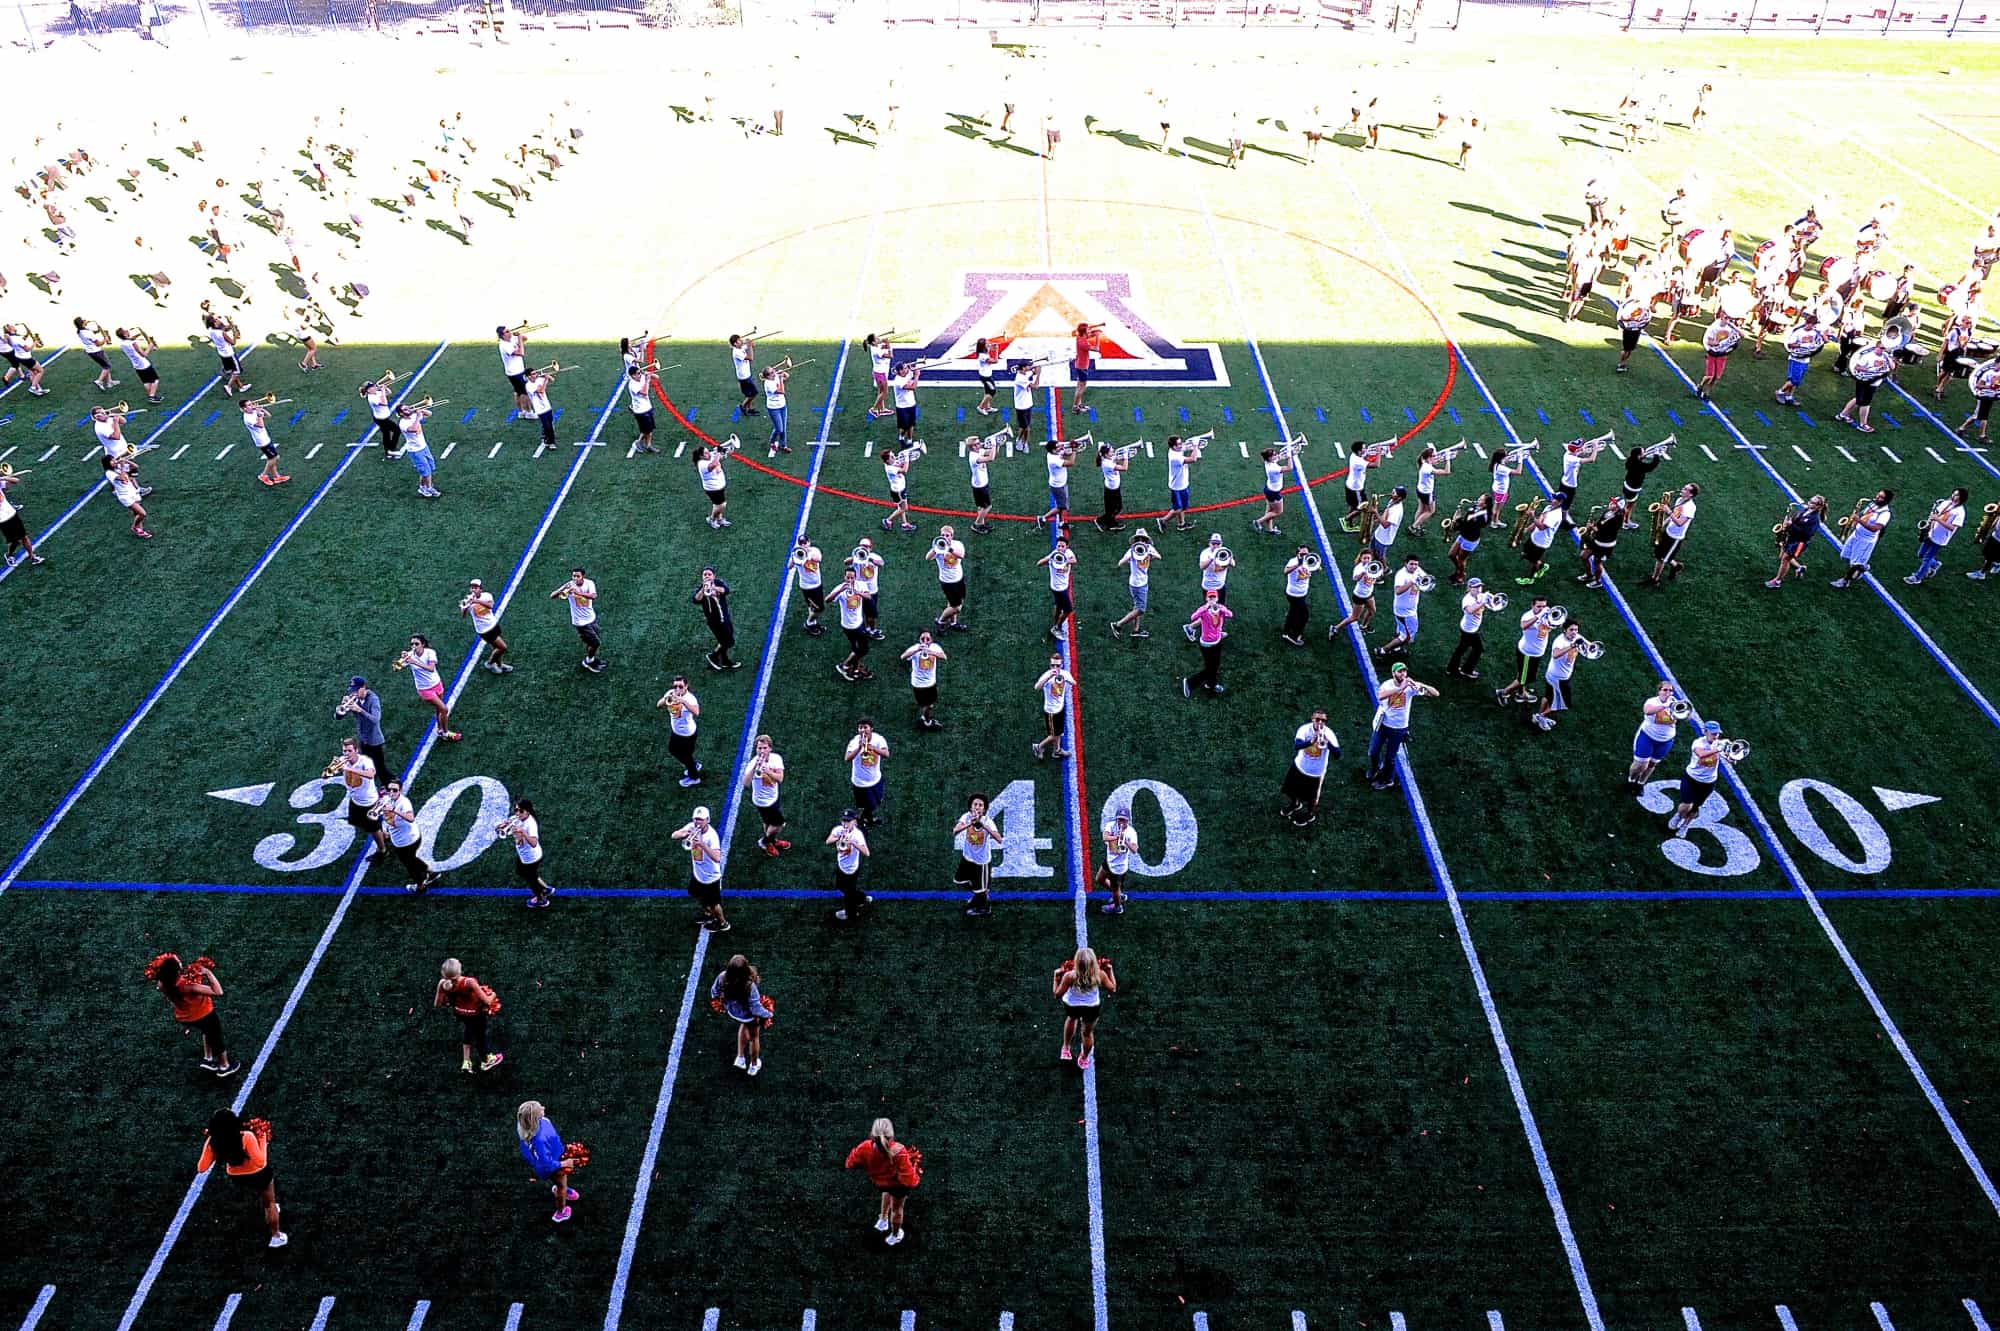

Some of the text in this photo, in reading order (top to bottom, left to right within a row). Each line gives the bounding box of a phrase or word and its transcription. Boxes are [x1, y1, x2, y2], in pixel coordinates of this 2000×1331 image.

[882, 270, 1228, 386] A
[253, 775, 510, 872] 30
[953, 778, 1199, 878] 40
[1637, 778, 1892, 876] 30
